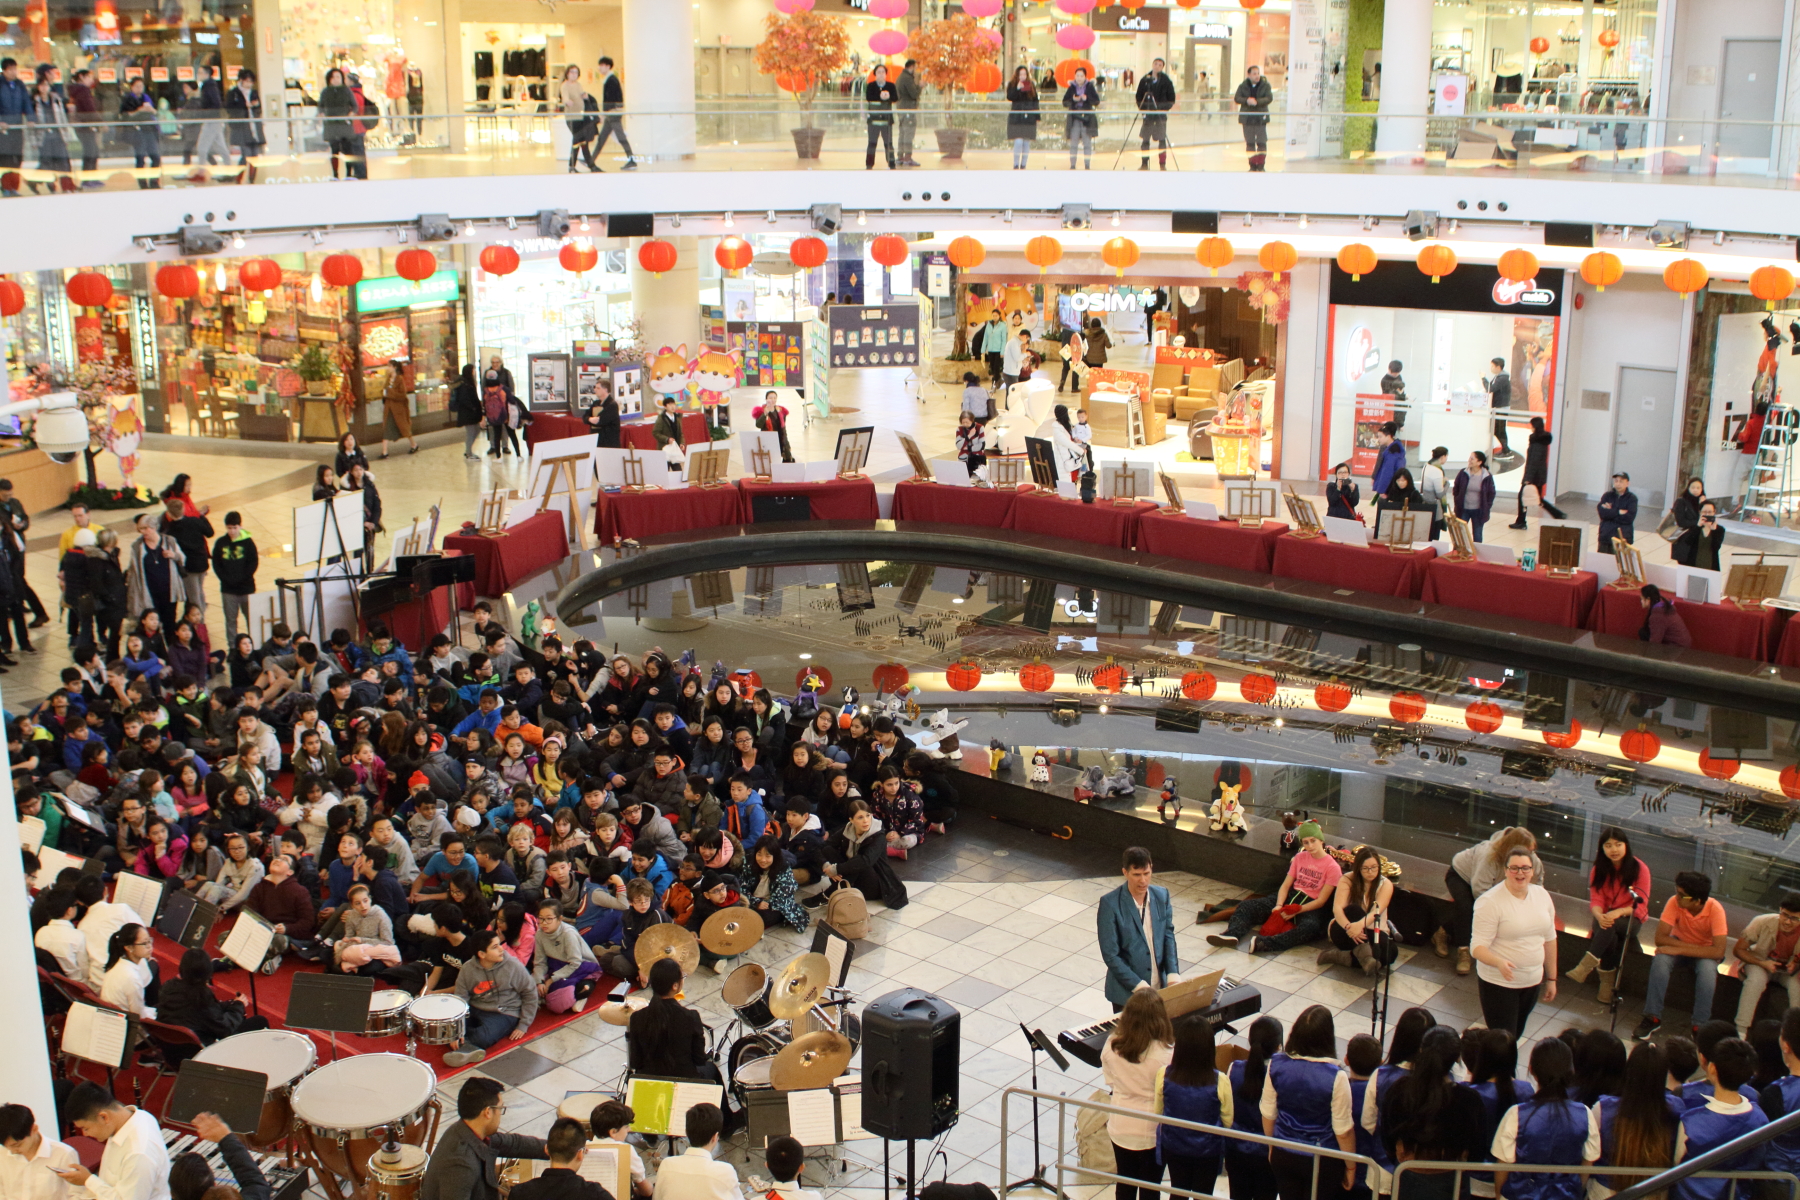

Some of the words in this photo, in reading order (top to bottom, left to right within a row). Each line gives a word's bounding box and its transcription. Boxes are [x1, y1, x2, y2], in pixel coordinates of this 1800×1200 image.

[1119, 15, 1150, 30] CanCan
[1070, 292, 1136, 313] OSIM
[1522, 291, 1549, 303] mobile
[803, 986, 817, 1003] SABIAN
